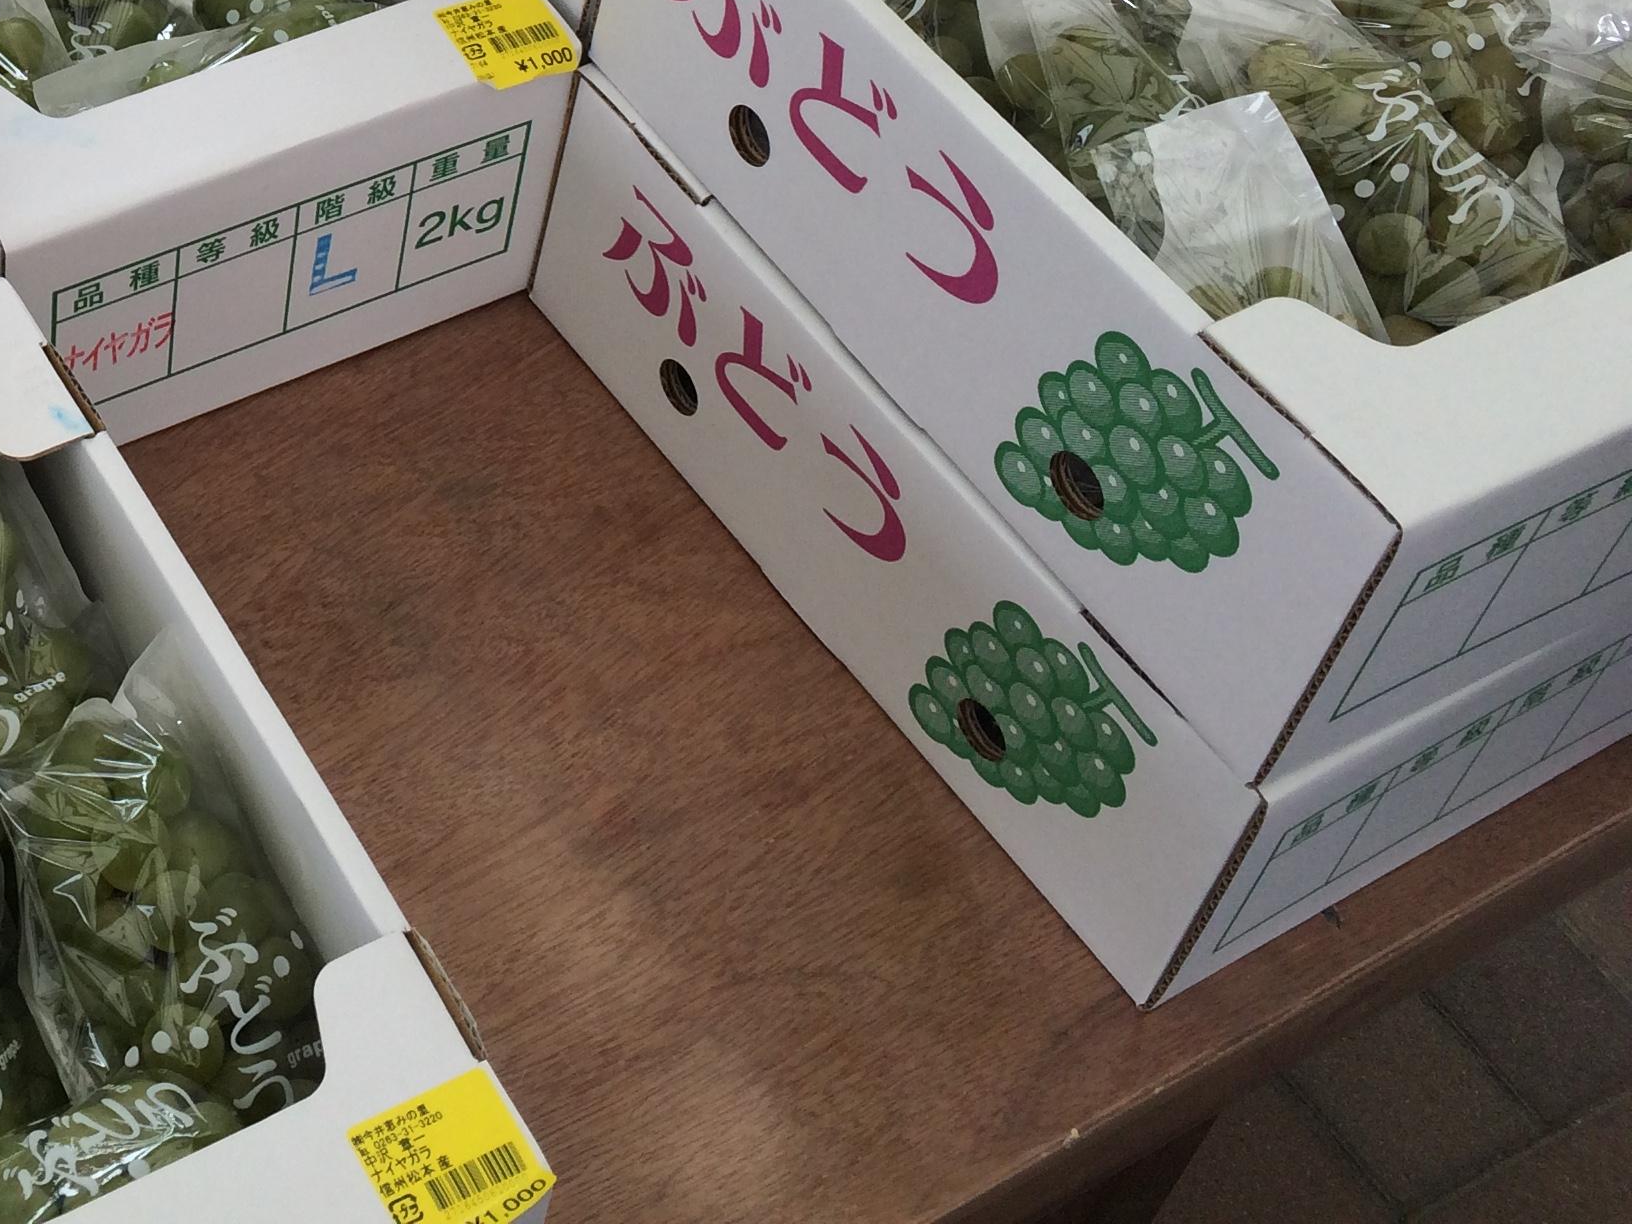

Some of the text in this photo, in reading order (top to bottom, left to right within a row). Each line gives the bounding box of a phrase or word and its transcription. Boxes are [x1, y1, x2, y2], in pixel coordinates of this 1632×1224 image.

[514, 47, 573, 72] ¥1,000
[431, 134, 511, 183] 重量
[1353, 69, 1516, 247] ぶどう
[315, 174, 395, 222] 階級
[414, 193, 505, 252] 2kg
[198, 216, 280, 264] 等級
[309, 233, 357, 296] L
[73, 260, 161, 313] 品種
[64, 312, 176, 372] ナイヤガラ
[602, 185, 907, 562] ぶどう
[13, 671, 66, 703] grape
[180, 908, 296, 1110] ぶどう
[371, 1145, 432, 1183] ナイヤガラ
